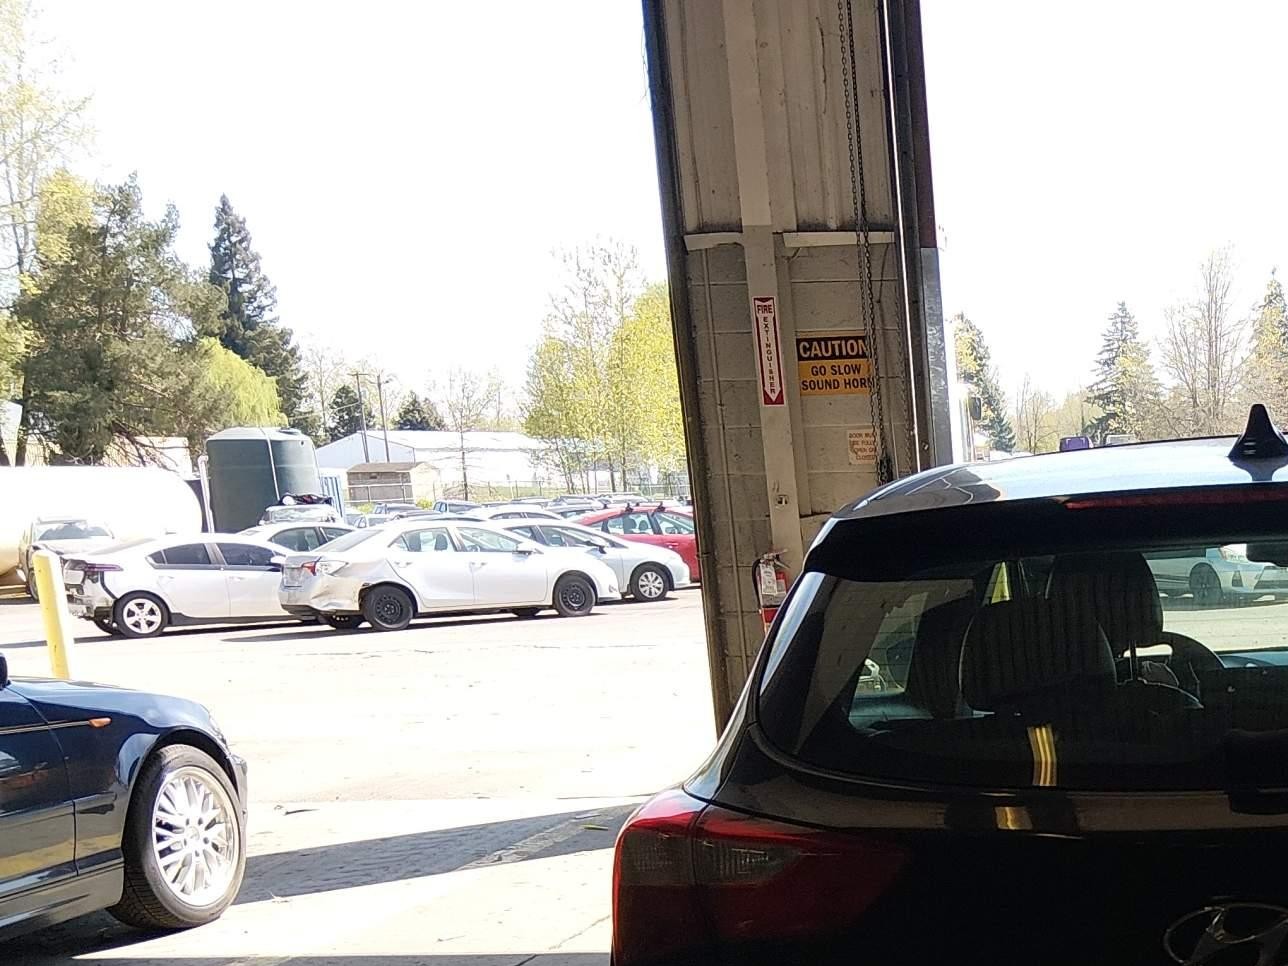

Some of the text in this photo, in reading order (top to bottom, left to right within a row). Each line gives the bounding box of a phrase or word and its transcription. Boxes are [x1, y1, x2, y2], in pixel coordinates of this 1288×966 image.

[757, 305, 773, 314] FIRE
[762, 317, 776, 394] EXTINGUISHER
[799, 340, 869, 358] CAUTION
[811, 364, 861, 376] GO SLOW
[801, 377, 875, 391] SOUND HORN
